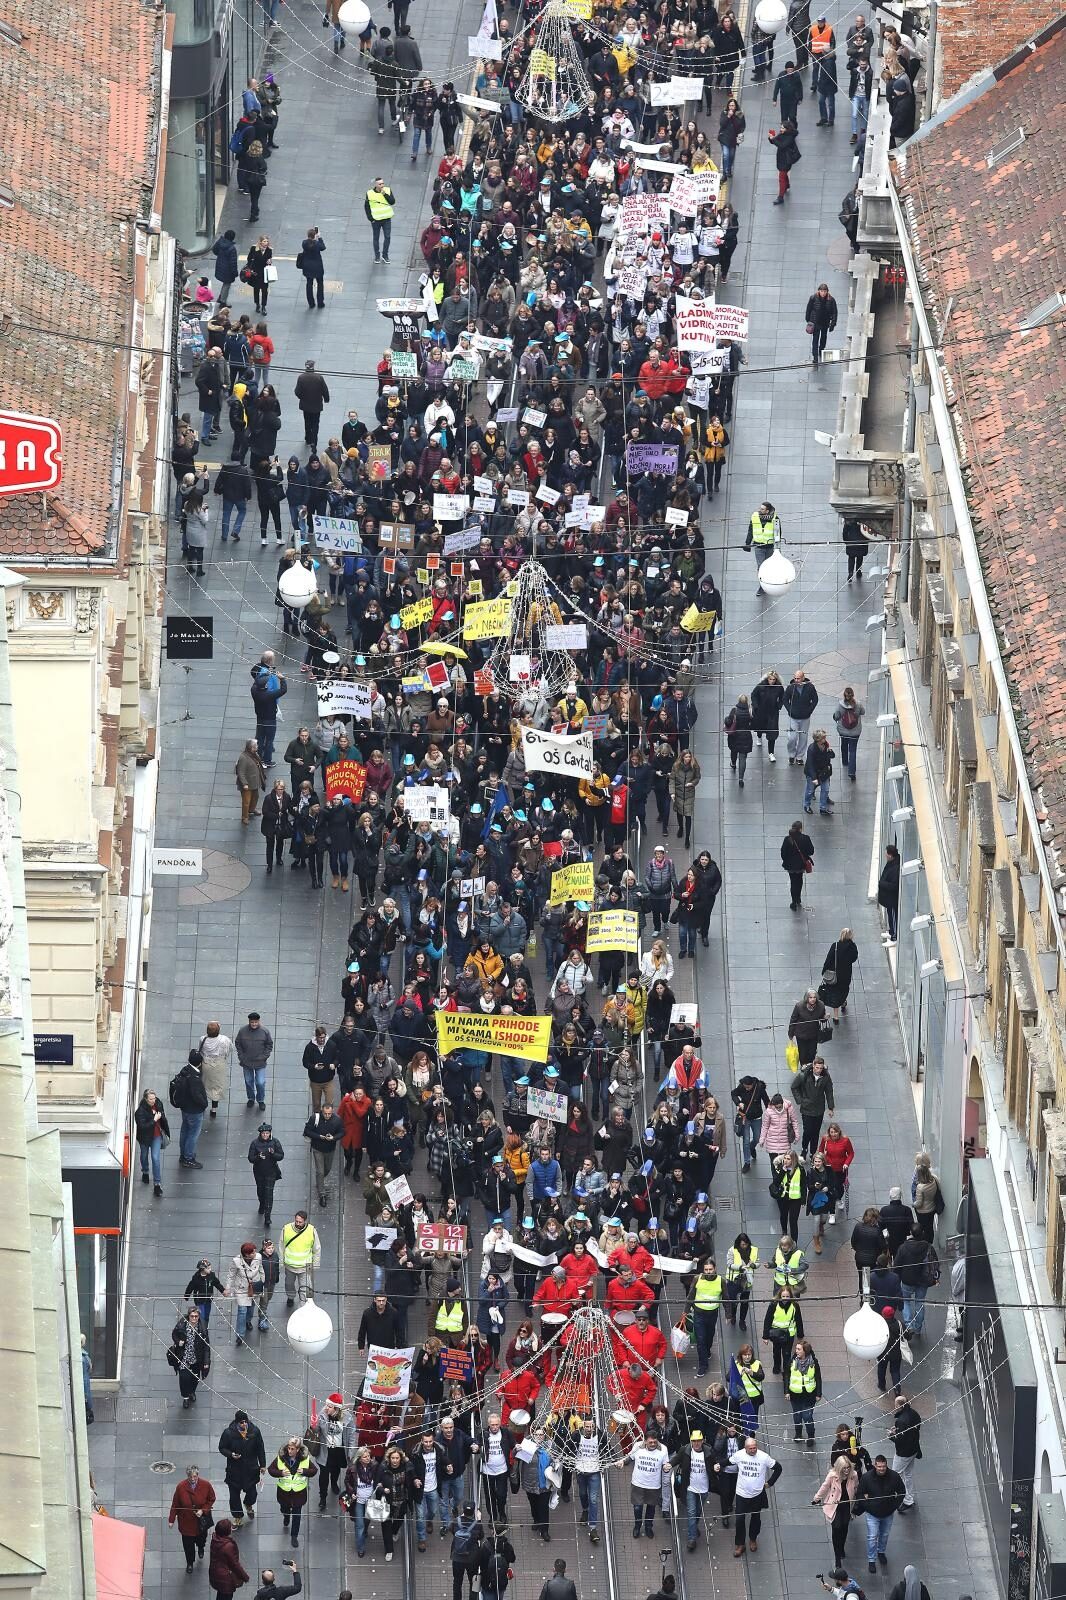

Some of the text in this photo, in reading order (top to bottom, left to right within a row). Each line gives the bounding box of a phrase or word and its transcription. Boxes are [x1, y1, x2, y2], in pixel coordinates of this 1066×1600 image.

[314, 517, 358, 537] STRAJK
[316, 533, 330, 543] ZA
[543, 748, 561, 766] OŠ
[445, 1016, 541, 1034] VI NAMA PRIHODE
[447, 1026, 536, 1045] MI VAMA ISHODE
[422, 1225, 463, 1238] 5 12
[421, 1239, 459, 1251] 6 11
